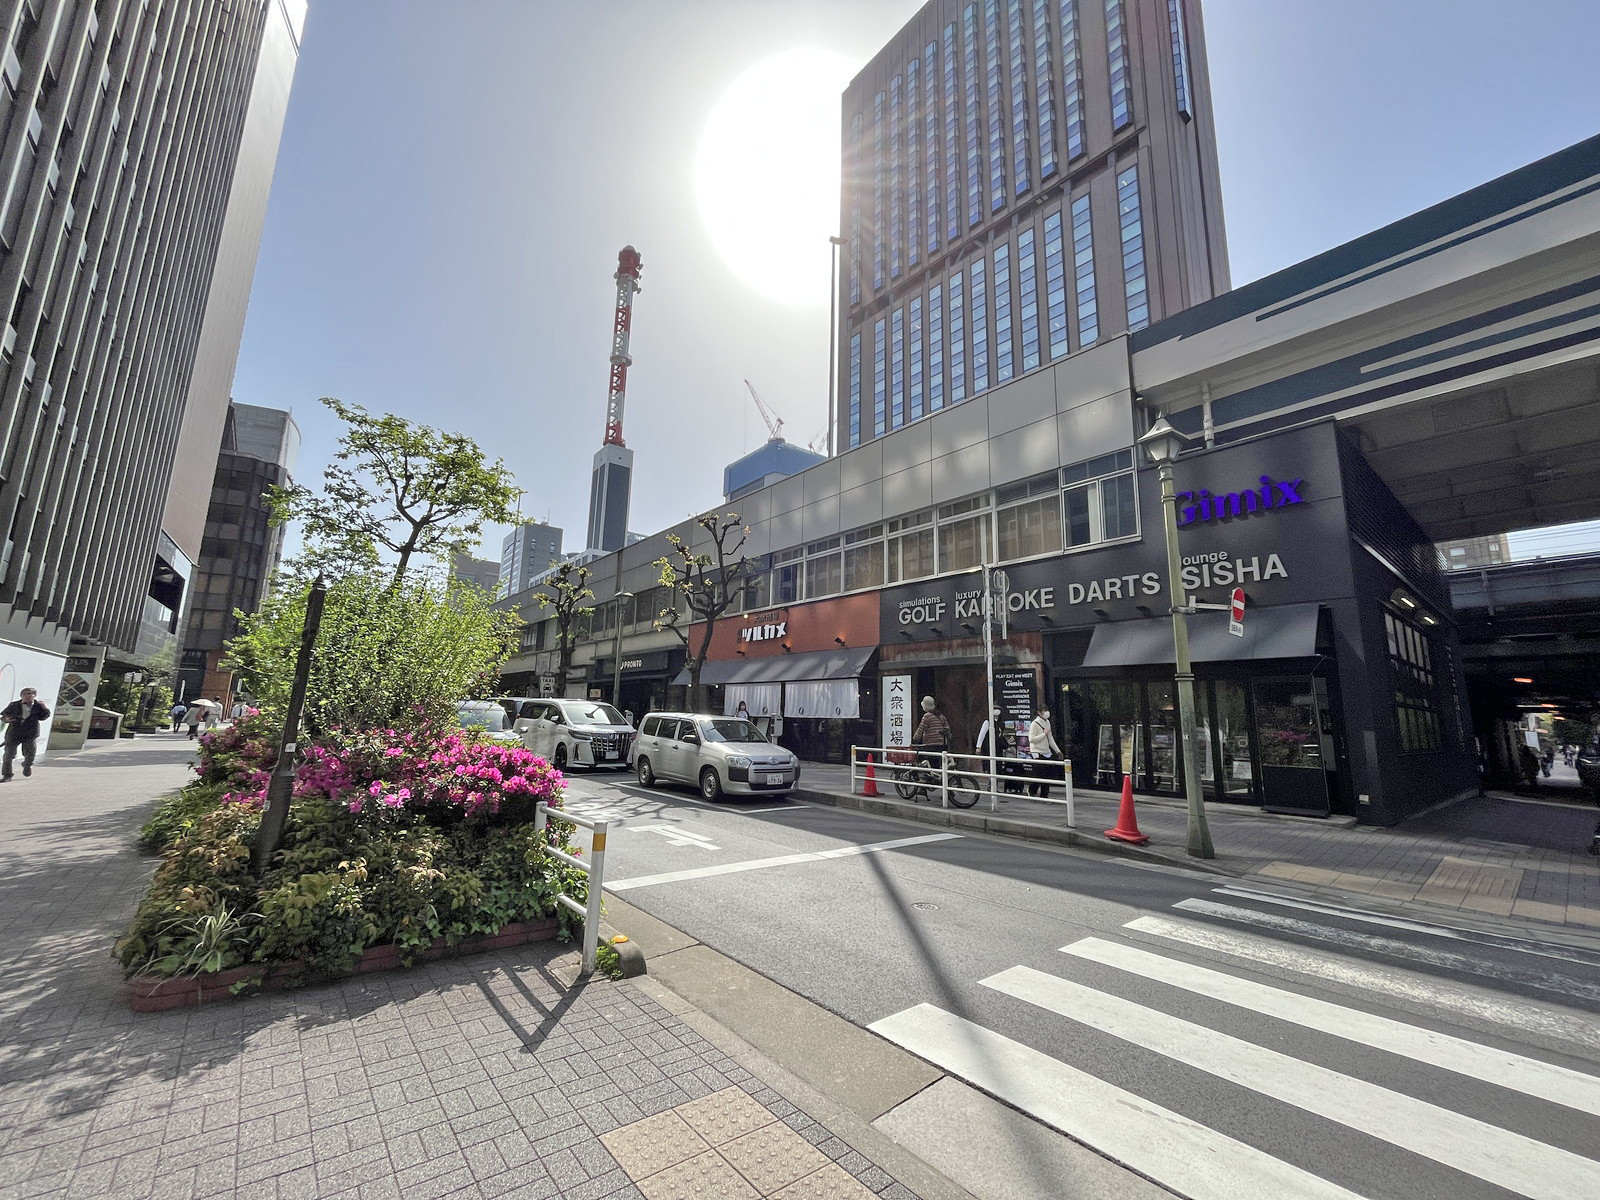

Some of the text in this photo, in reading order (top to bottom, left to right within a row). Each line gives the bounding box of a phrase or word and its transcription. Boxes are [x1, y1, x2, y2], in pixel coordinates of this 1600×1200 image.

[1175, 475, 1303, 526] Gimix
[899, 553, 1288, 625] GOLF KAROKE DARTS SISHA
[899, 589, 981, 608] simulations luxury
[890, 678, 904, 746] 大衆酒場
